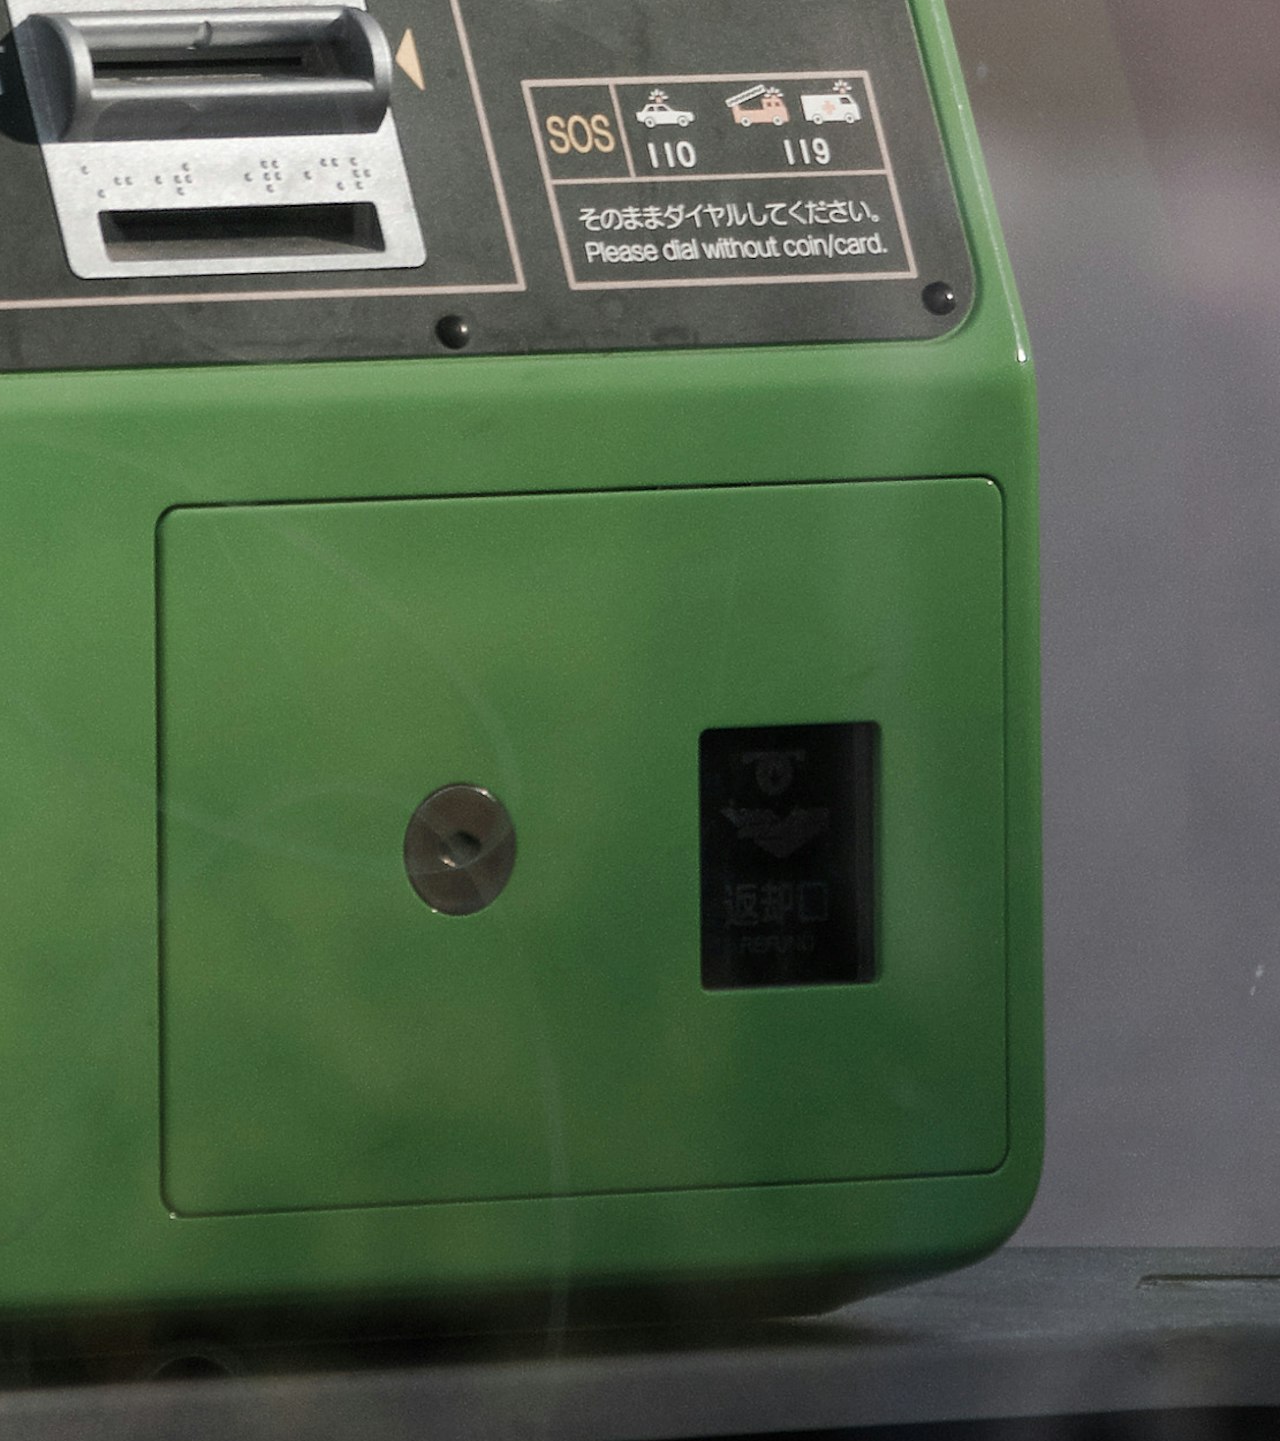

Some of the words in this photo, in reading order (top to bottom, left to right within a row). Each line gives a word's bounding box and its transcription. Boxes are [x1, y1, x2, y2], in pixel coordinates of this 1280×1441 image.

[546, 113, 616, 155] SOS
[647, 139, 698, 169] 110
[783, 137, 832, 166] 119
[578, 199, 881, 232] そのままダイヤルしてください。
[584, 240, 659, 264] Please
[662, 238, 700, 262] dial
[701, 235, 781, 261] without
[783, 232, 889, 259] coin/card.
